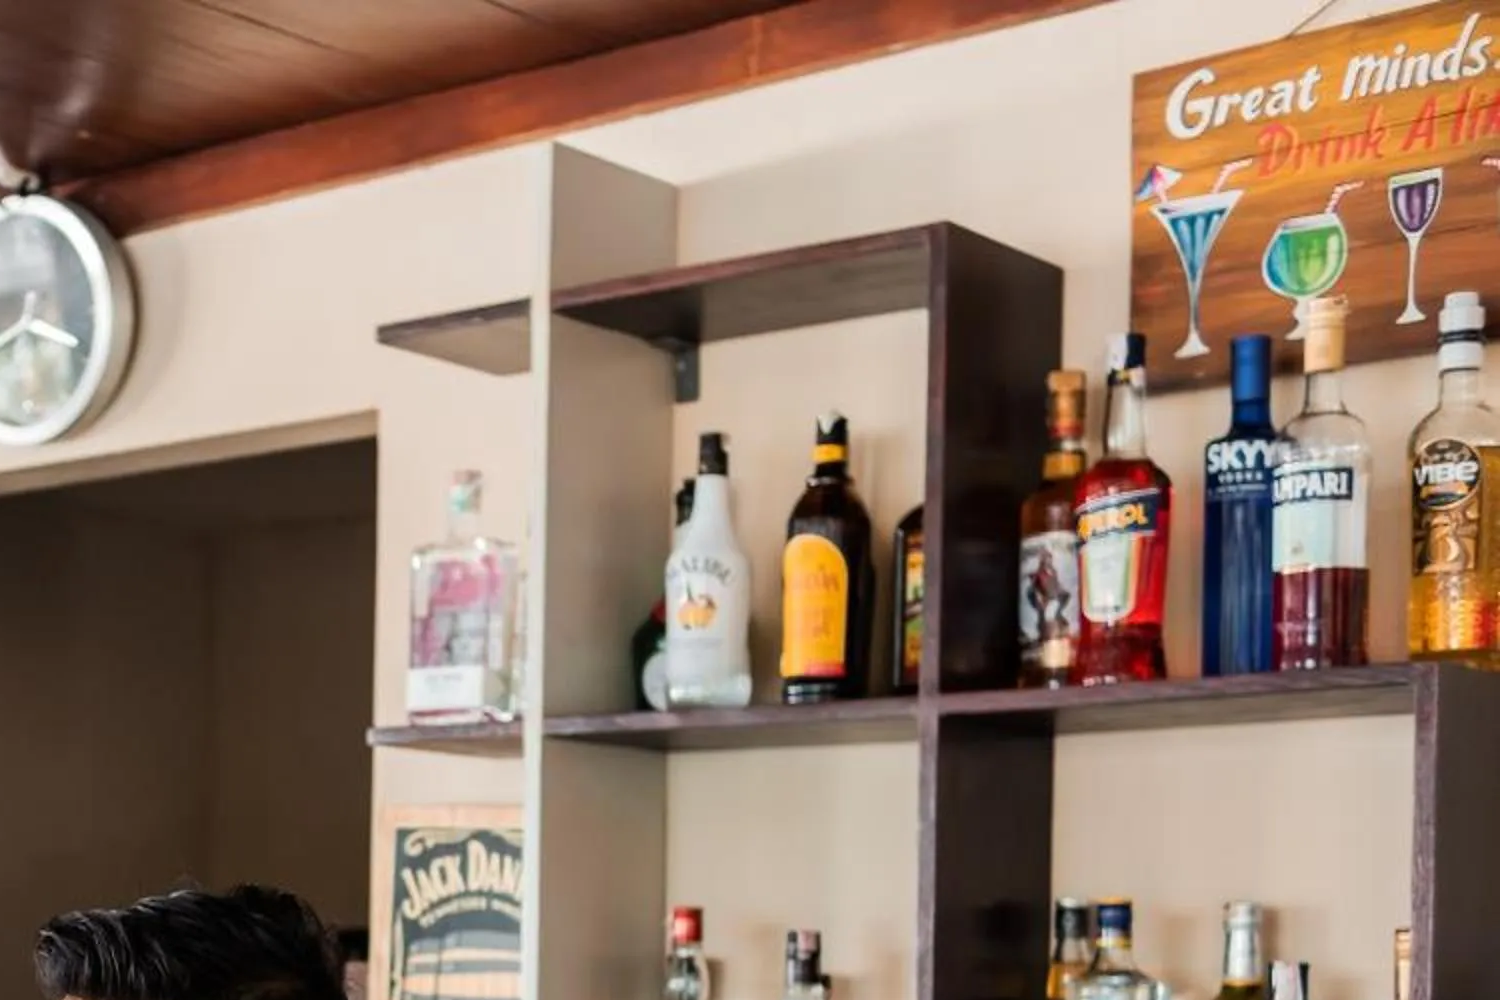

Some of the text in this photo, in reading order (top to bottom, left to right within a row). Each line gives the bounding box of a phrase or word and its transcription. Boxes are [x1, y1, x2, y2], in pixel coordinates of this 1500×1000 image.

[1165, 65, 1322, 140] Great
[1257, 103, 1386, 178] Drink
[1402, 95, 1438, 152] A
[1207, 439, 1278, 474] SKYY
[401, 854, 466, 920] JACK
